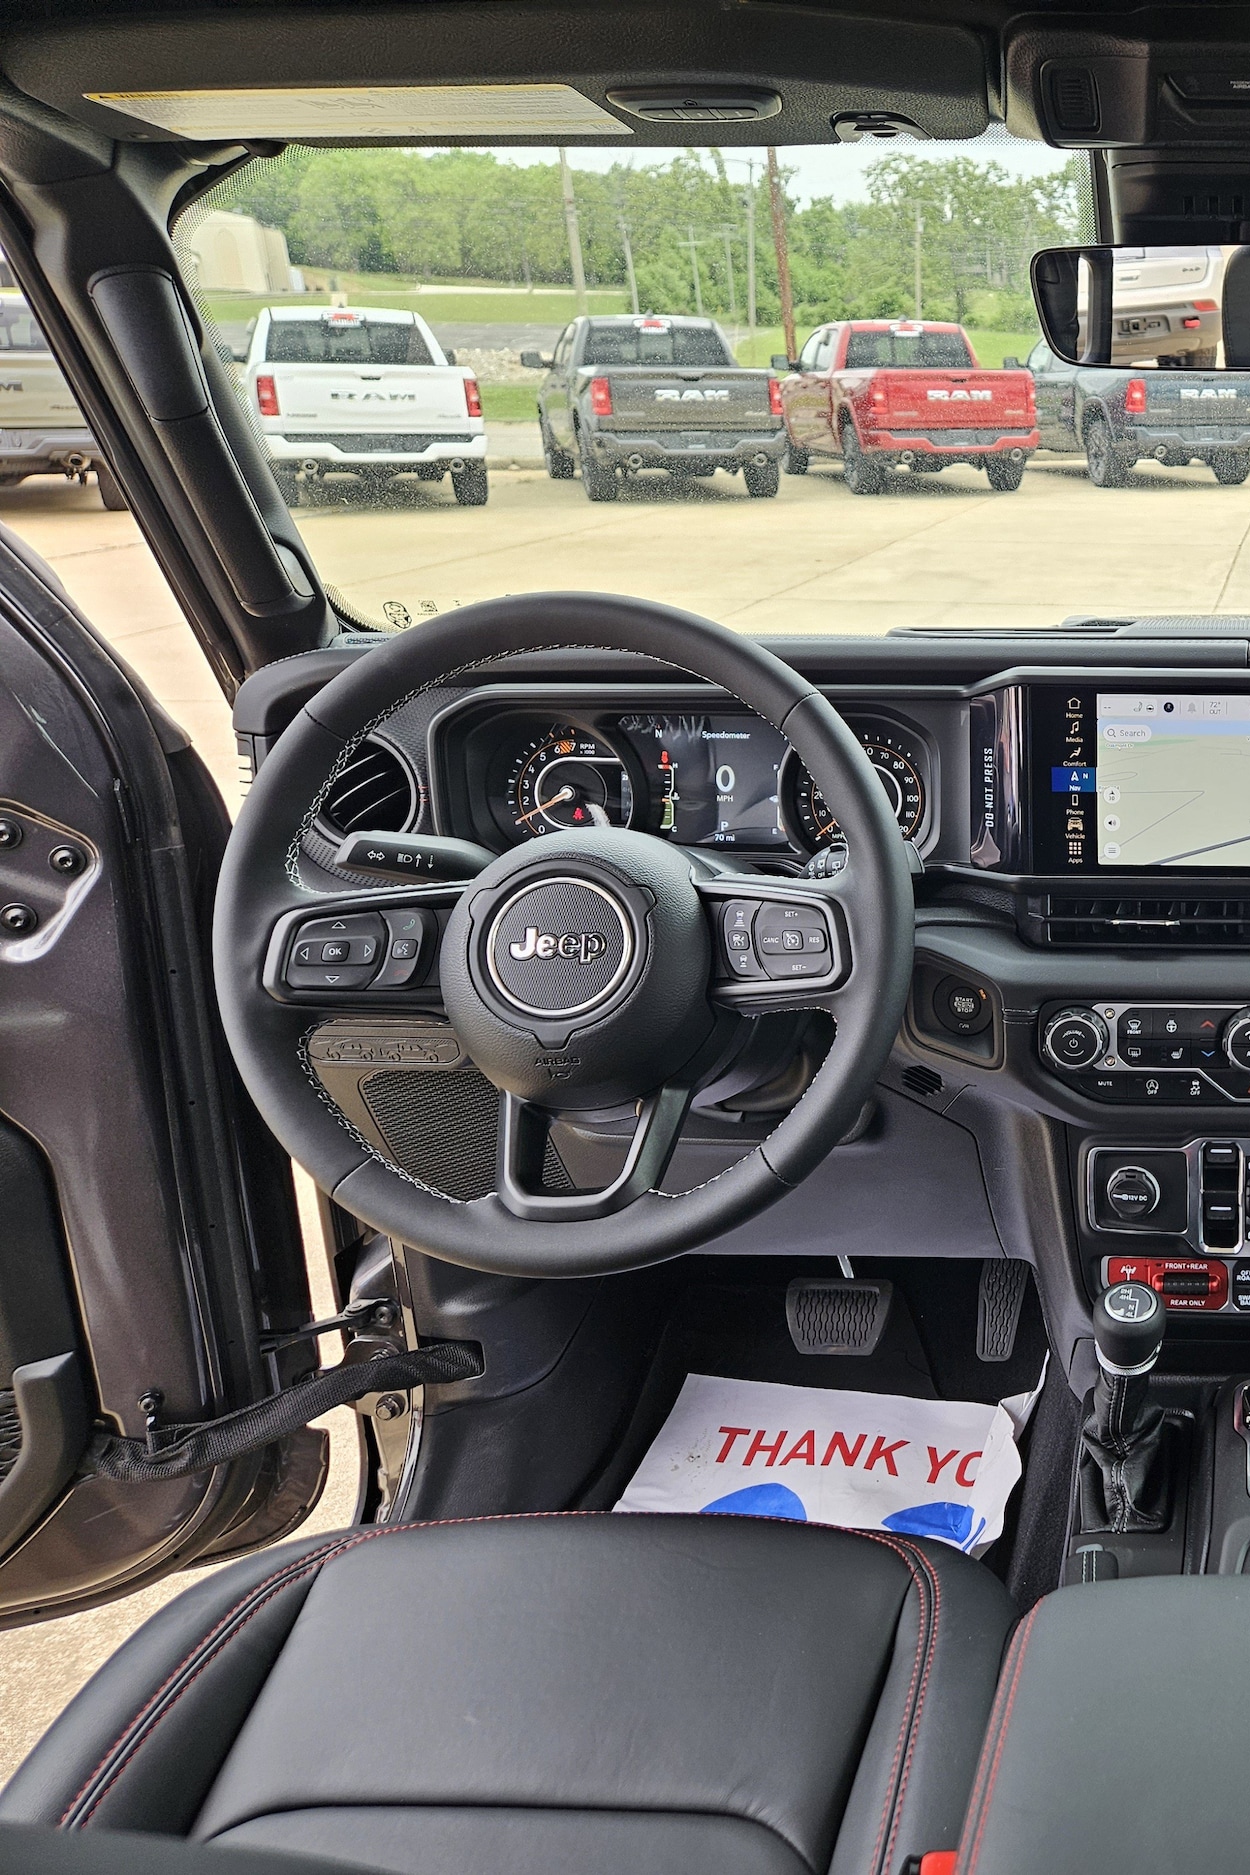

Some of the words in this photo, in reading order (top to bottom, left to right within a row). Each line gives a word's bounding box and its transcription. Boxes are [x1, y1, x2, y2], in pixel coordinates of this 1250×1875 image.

[330, 389, 416, 402] RAM
[655, 389, 729, 401] RAM
[927, 390, 992, 400] RAM
[1180, 389, 1237, 399] RAM
[655, 729, 663, 738] N
[701, 731, 751, 740] Speedometer
[1119, 729, 1146, 737] Search
[554, 744, 560, 754] 6
[570, 742, 577, 752] 7
[540, 752, 546, 761] 5
[880, 751, 890, 760] 70
[528, 765, 535, 773] 4
[893, 761, 905, 770] 80
[983, 747, 993, 784] PRESS
[715, 764, 736, 793] 0
[904, 776, 914, 784] 90
[523, 780, 530, 789] 3
[523, 796, 529, 806] 2
[906, 794, 919, 803] 100
[984, 787, 994, 809] NOT
[818, 809, 826, 817] 10
[905, 811, 915, 819] 110
[1066, 808, 1084, 816] Phone
[984, 812, 994, 828] DO
[538, 825, 546, 834] 0
[720, 821, 729, 831] P
[714, 834, 725, 842] 70
[725, 834, 736, 842] mi
[1068, 857, 1083, 865] Apps
[510, 926, 607, 964] Jeep
[328, 947, 342, 956] OK
[535, 1056, 581, 1067] AIRBAG
[715, 1426, 910, 1476] THANK
